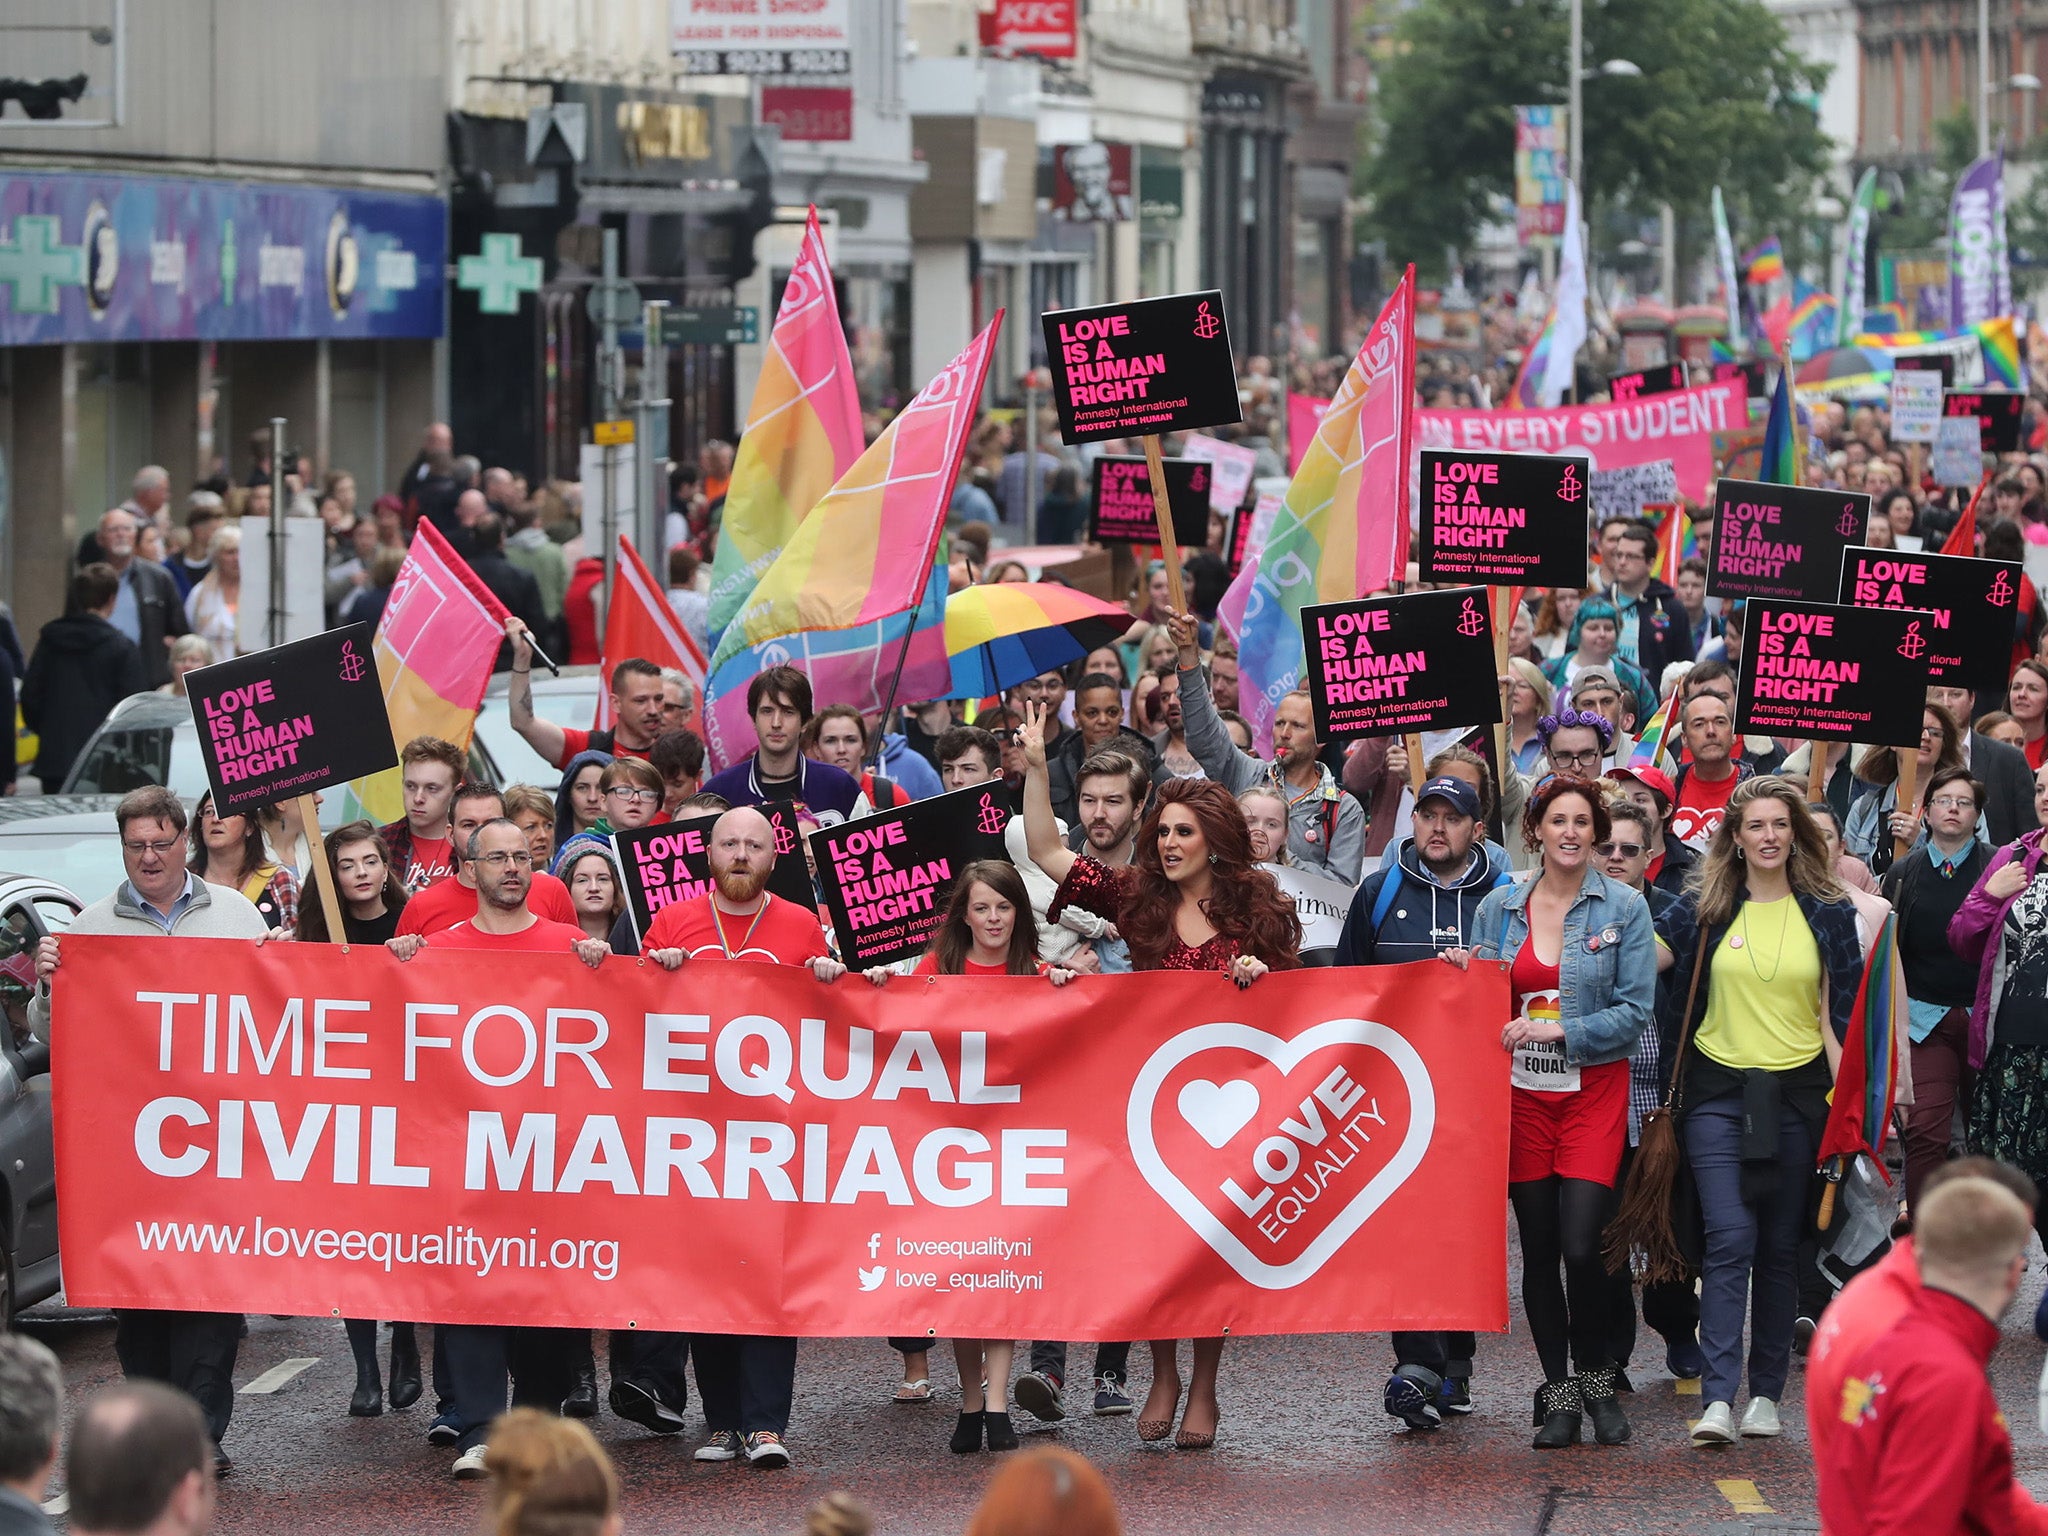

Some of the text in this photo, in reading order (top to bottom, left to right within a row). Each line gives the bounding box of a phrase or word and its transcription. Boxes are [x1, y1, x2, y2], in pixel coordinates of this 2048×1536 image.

[1000, 1, 1066, 27] KFC
[1058, 315, 1130, 342] LOVE
[1062, 339, 1115, 364] IS A
[1066, 353, 1166, 385] HUMAN
[1069, 378, 1150, 406] RIGHT
[1074, 397, 1188, 421] Amnesty International
[1421, 386, 1731, 448] IN EVERY STUDENT
[1075, 413, 1173, 432] PROTECT THE HUMAN
[1102, 462, 1150, 478] LOVE
[1434, 462, 1498, 484] LOVE
[1101, 477, 1135, 491] IS A
[1434, 483, 1481, 505] IS A
[1100, 491, 1154, 505] HUMA
[1099, 505, 1155, 520] RIGHT
[1434, 505, 1525, 528] HUMAN
[1723, 501, 1782, 524] LOVE
[1433, 526, 1509, 548] RIGHT
[1721, 519, 1763, 540] IS A
[1433, 550, 1540, 564] Amnesty International
[1719, 538, 1802, 562] HUMAN
[1432, 564, 1524, 575] PROTECT THE HUMAN
[1717, 555, 1786, 579] RIGHT
[1857, 559, 1927, 584] LOVE
[1716, 580, 1803, 597] Amnesty International
[1854, 580, 1904, 604] IS A
[1317, 609, 1391, 638] LOVE
[1761, 611, 1835, 637] LOVE
[1320, 635, 1374, 660] IS A
[1758, 633, 1811, 657] IS A
[1323, 650, 1427, 683] HUMAN
[1756, 655, 1860, 684] HUMAN
[203, 679, 276, 719] LOVE
[1326, 675, 1410, 705] RIGHT
[1753, 677, 1839, 703] RIGHT
[1329, 697, 1448, 720] Amnesty International
[1752, 702, 1871, 721] Amnesty International
[208, 708, 262, 741] IS A
[1330, 713, 1431, 732] PROTECT THE HUMAN
[1750, 716, 1852, 732] PROTECT THE HUMAN
[214, 714, 315, 763] HUMAN
[218, 742, 300, 785] RIGHT
[228, 766, 331, 804] Amnesty International
[828, 820, 907, 862] LOVE
[1689, 817, 1719, 841] OVE
[633, 830, 705, 864] LOVE
[639, 859, 693, 888] IS A
[835, 851, 894, 885] IS A
[841, 858, 952, 908] HUMAN
[847, 886, 936, 931] RIGHT
[855, 924, 906, 946] Amnesty
[908, 912, 950, 931] Interna
[857, 939, 904, 959] PROTECT
[905, 932, 926, 945] THE
[135, 991, 1021, 1105] TIME FOR EQUAL
[1525, 1056, 1567, 1074] EQUAL
[134, 1095, 1069, 1208] CIVIL MARRIAGE
[1219, 1064, 1367, 1219] LOVE
[1256, 1097, 1387, 1244] EQUALITY
[135, 1216, 620, 1281] www.loveequalityni.org
[896, 1236, 1032, 1260] loveequalityni
[895, 1269, 1043, 1294] love_equalityni
